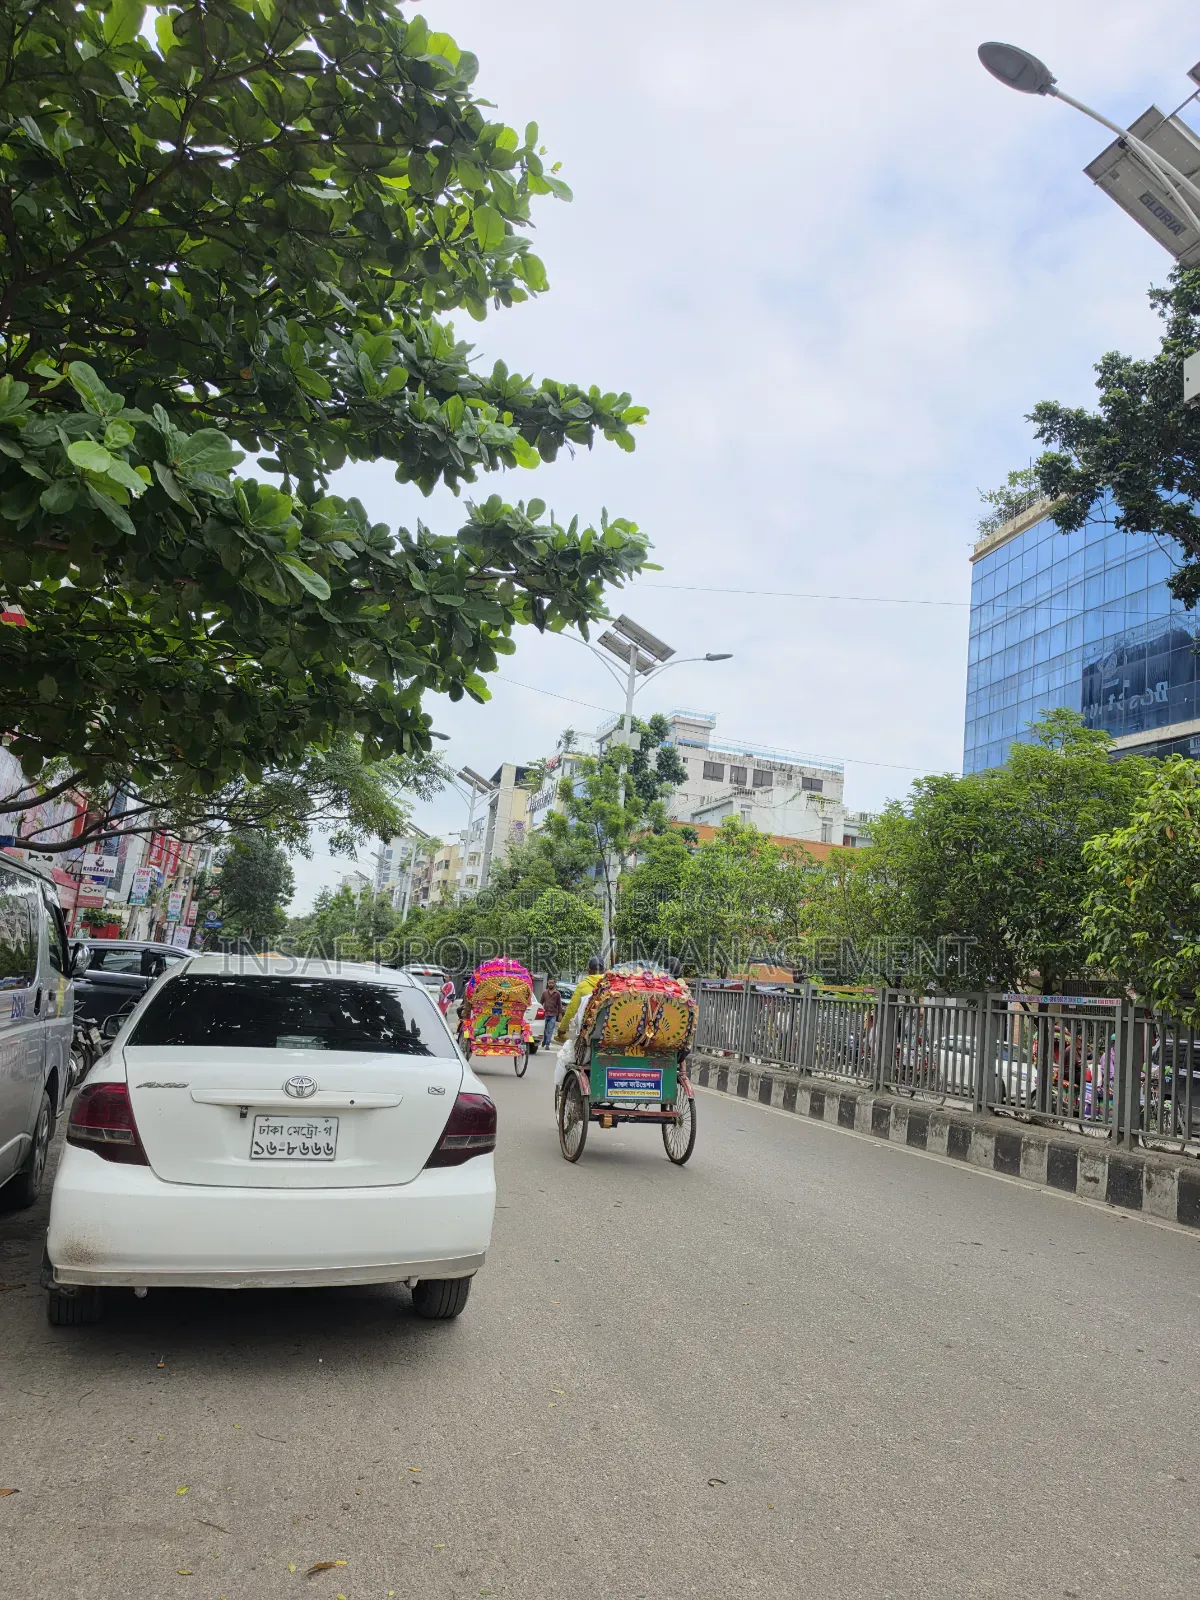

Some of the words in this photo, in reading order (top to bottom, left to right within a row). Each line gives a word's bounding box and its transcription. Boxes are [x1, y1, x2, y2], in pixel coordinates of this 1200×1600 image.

[1139, 193, 1182, 236] GLORIA
[259, 1125, 284, 1135] ঢাকা
[253, 1141, 334, 1156] ১৬-৮৬৬৬
